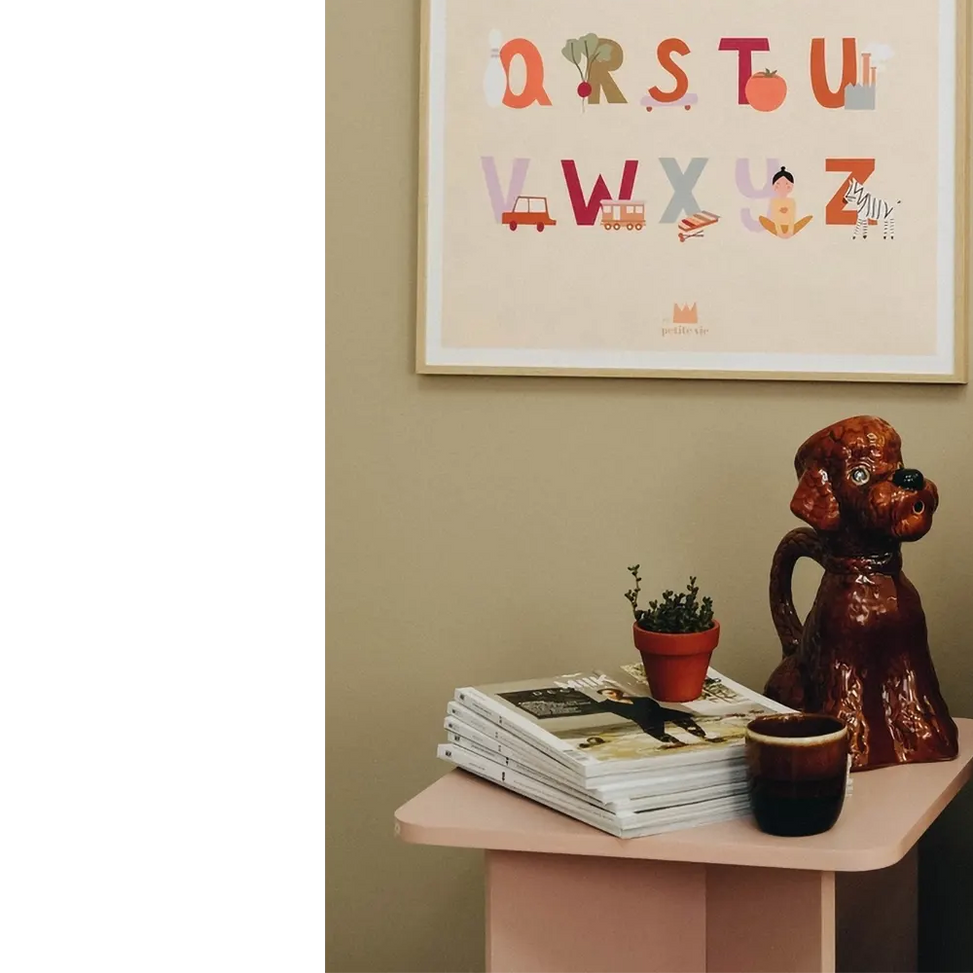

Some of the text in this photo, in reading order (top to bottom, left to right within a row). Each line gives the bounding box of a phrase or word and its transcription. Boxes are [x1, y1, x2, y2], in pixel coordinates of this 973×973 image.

[499, 37, 858, 109] Q R S T U
[480, 156, 531, 225] V
[561, 159, 639, 226] W
[658, 157, 709, 223] X
[825, 158, 878, 225] Z
